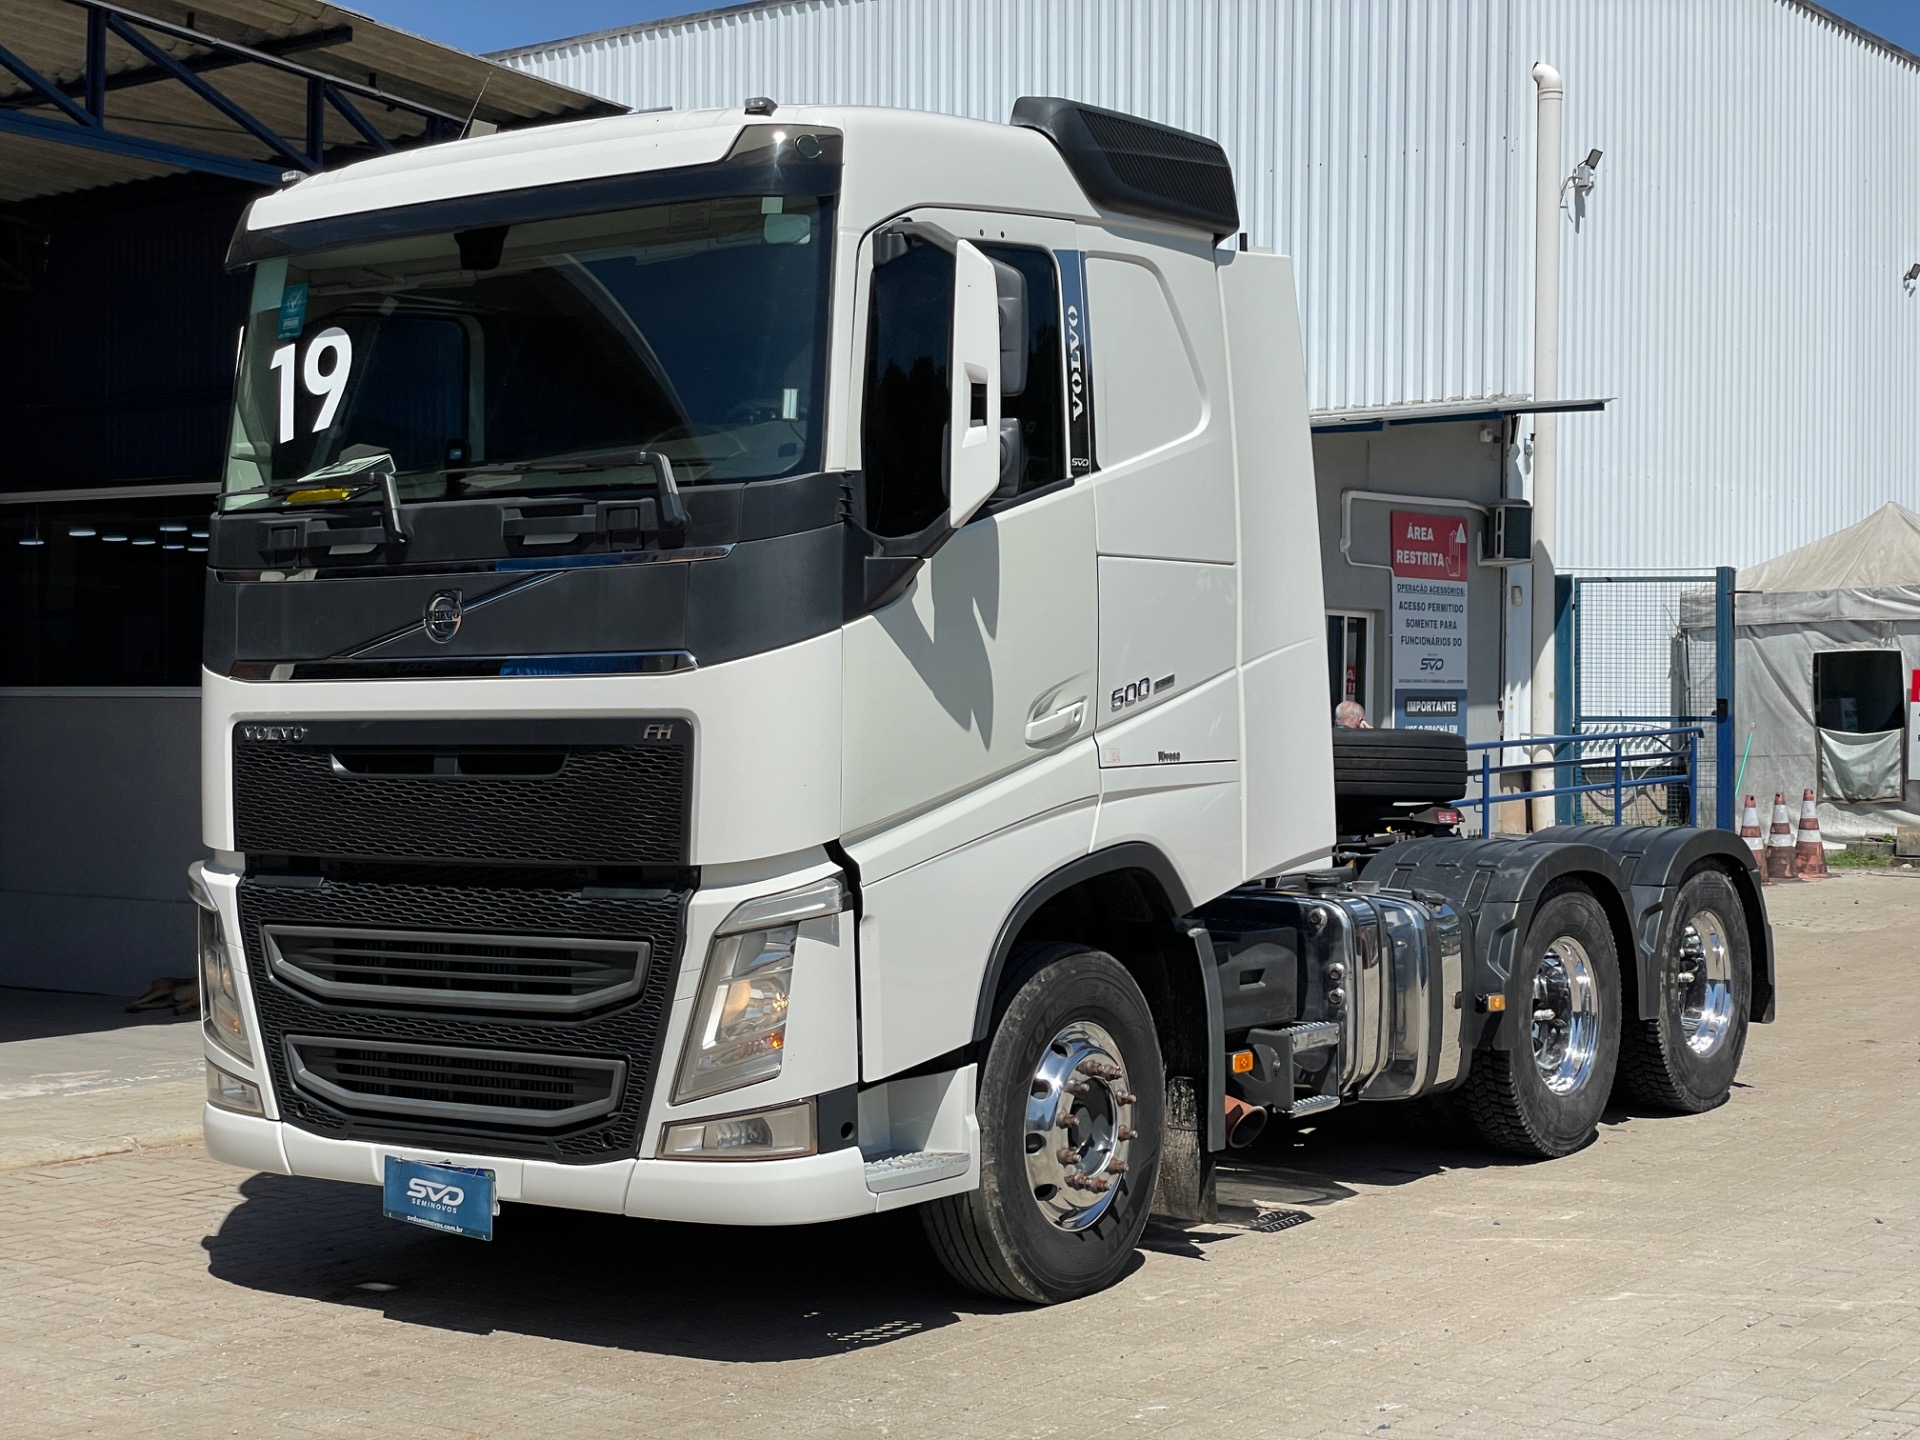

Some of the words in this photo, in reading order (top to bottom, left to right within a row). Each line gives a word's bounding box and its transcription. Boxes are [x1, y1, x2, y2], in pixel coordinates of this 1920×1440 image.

[1068, 305, 1084, 422] VOLVO
[270, 326, 353, 444] 19
[1071, 457, 1089, 467] SVD
[1407, 522, 1434, 541] ÁREA
[1396, 549, 1445, 567] RESTRITA
[1396, 583, 1428, 594] OPERAÇÃO
[1398, 601, 1426, 611] ACESSO
[1427, 602, 1464, 613] PERMITIDO
[1405, 618, 1438, 629] SOMENTE
[1439, 620, 1457, 630] PARA
[1400, 634, 1451, 647] FUNCIONÁRIOS
[1452, 637, 1462, 647] DO
[1420, 658, 1444, 671] SVD
[1111, 677, 1150, 708] 500
[1406, 701, 1457, 712] IMPORTANTE
[241, 726, 304, 741] VOLVO
[643, 724, 674, 740] FH
[406, 1177, 465, 1207] SVD
[411, 1198, 458, 1214] SEMINOVOS
[406, 1215, 464, 1234] svdseminovos.com.br
